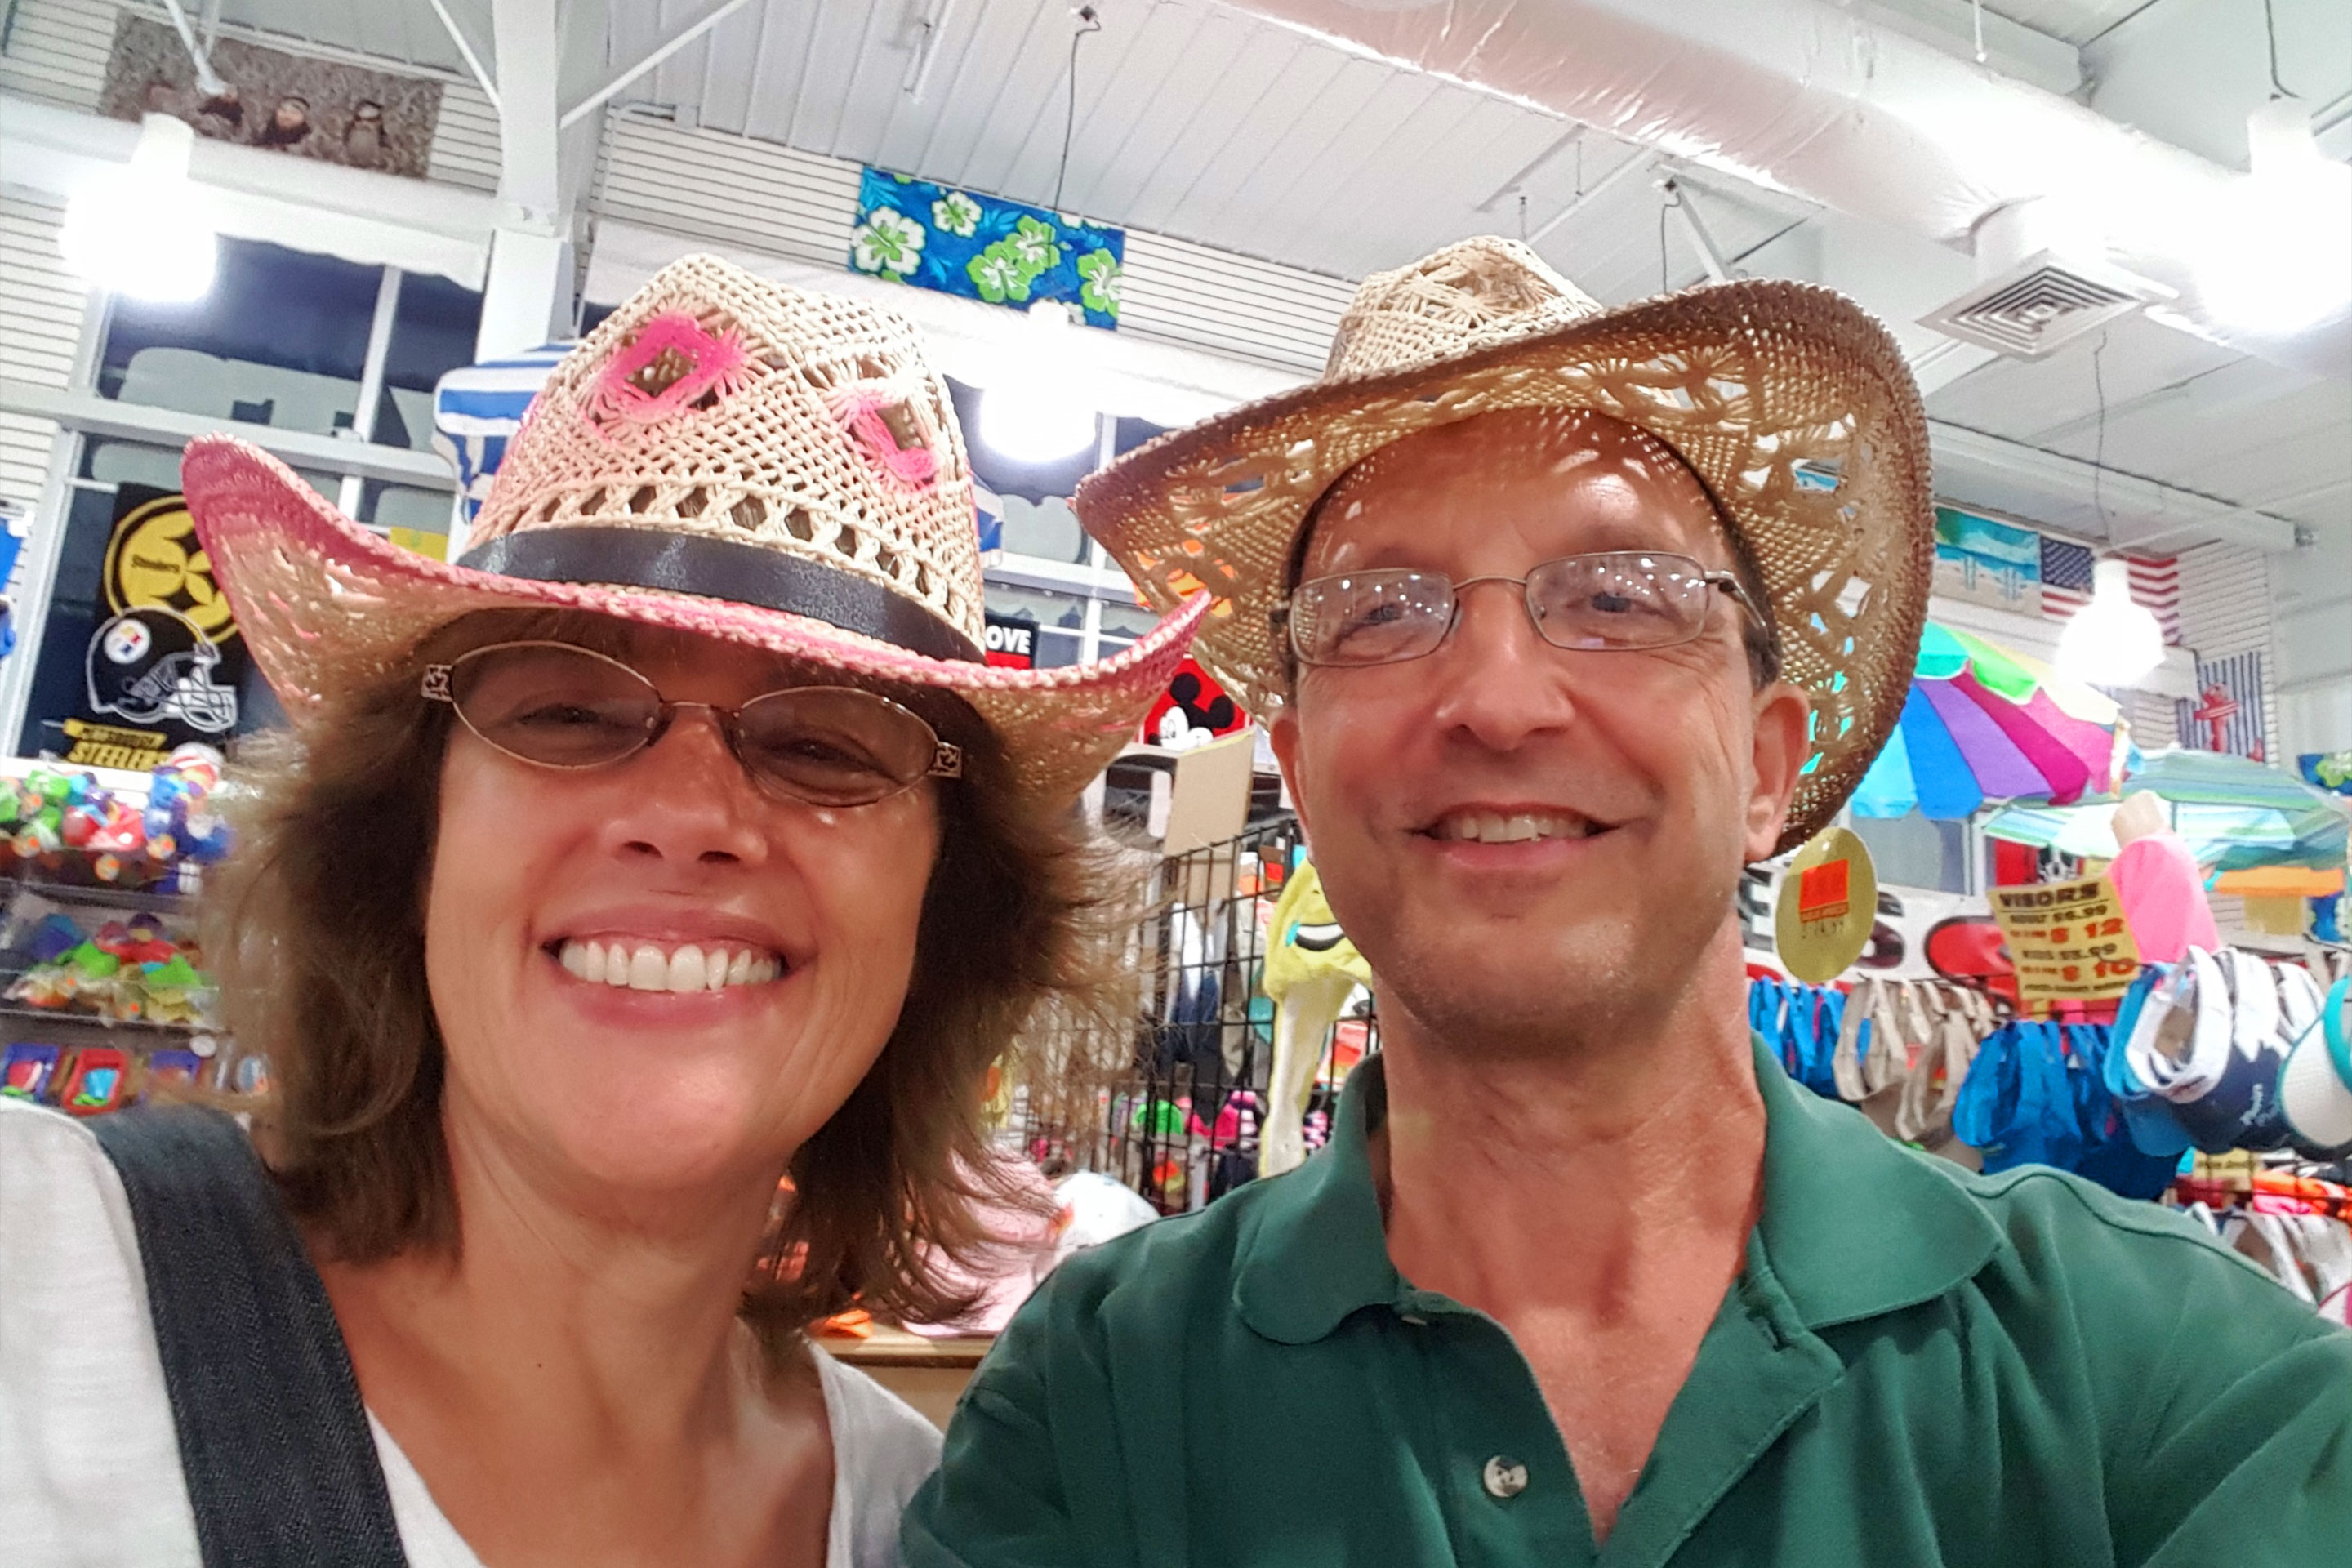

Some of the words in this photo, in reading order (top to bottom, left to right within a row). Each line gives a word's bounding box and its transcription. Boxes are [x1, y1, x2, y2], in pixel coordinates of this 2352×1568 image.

[1999, 882, 2099, 906] VISORS
[2085, 917, 2123, 938] 12
[2094, 957, 2136, 978] 10
